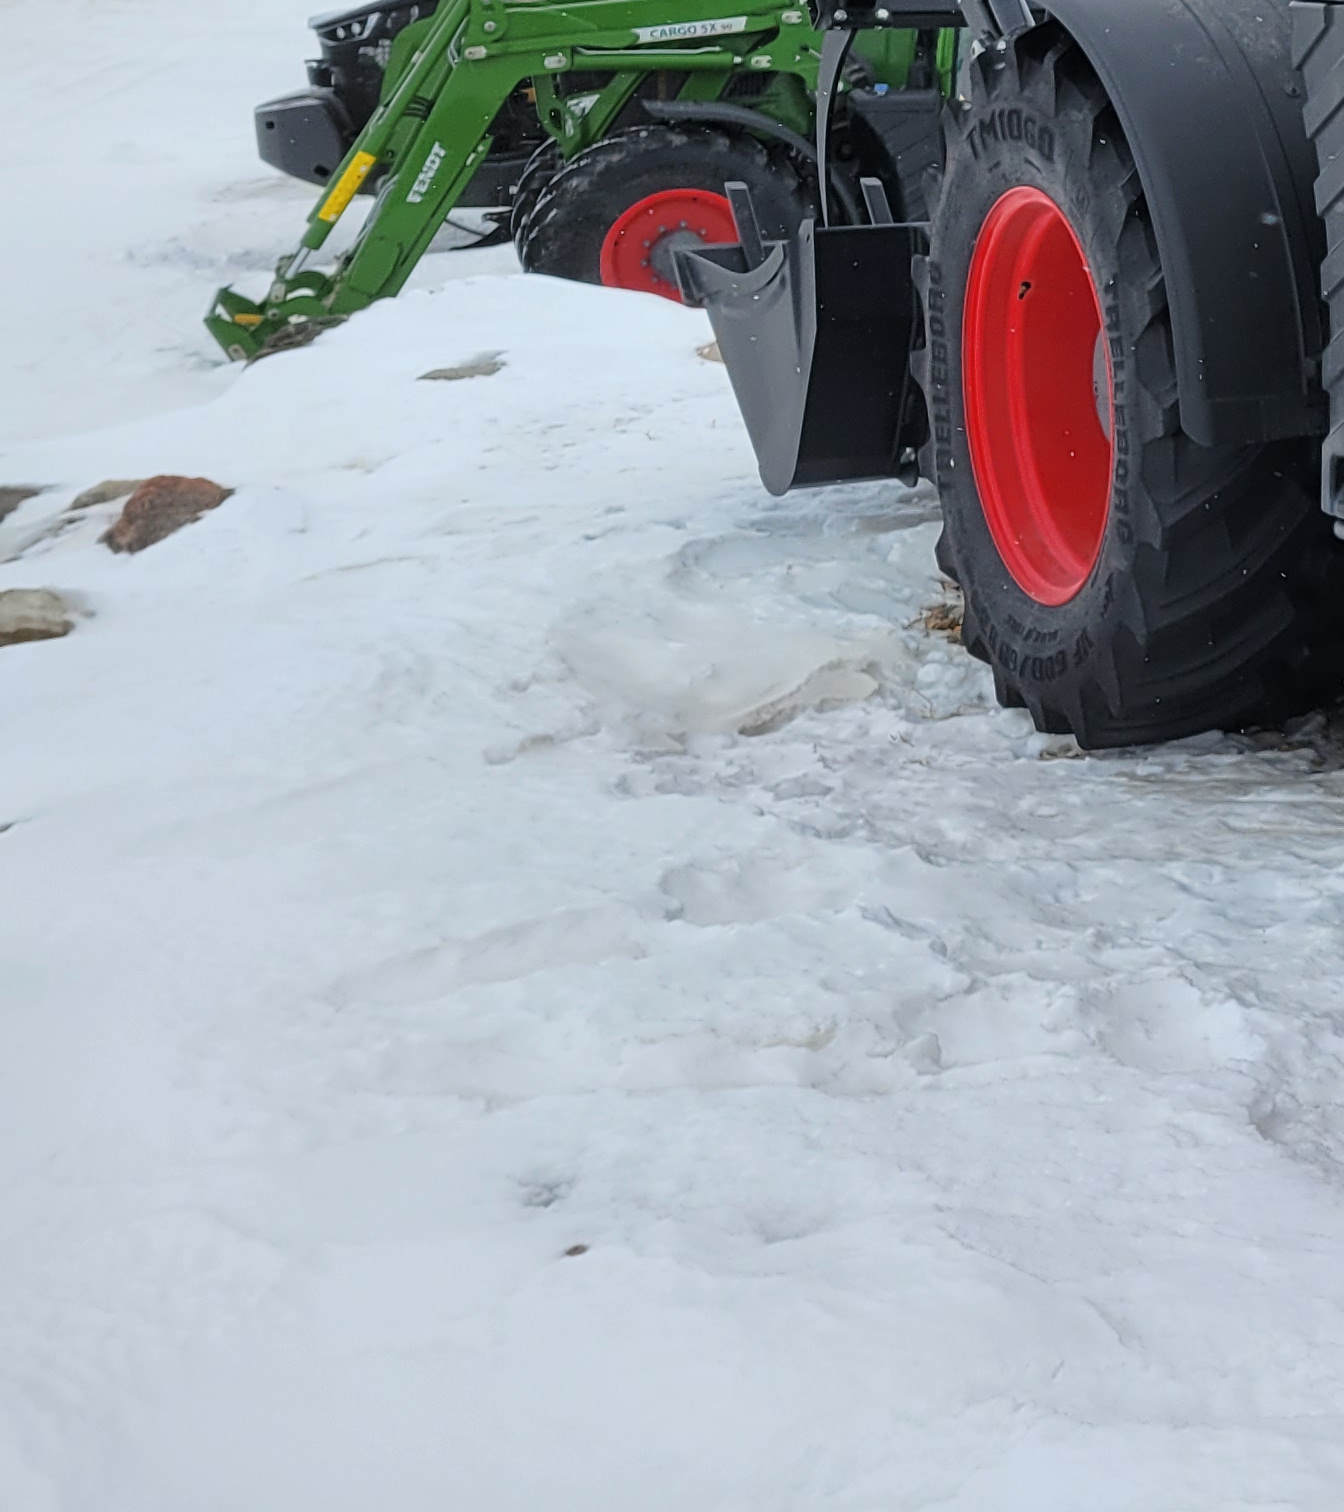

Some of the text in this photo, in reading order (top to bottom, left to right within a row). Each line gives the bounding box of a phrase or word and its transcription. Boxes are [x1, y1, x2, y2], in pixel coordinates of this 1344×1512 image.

[649, 25, 697, 38] CARGO
[964, 107, 1056, 164] TM1060
[405, 141, 447, 203] FENDT
